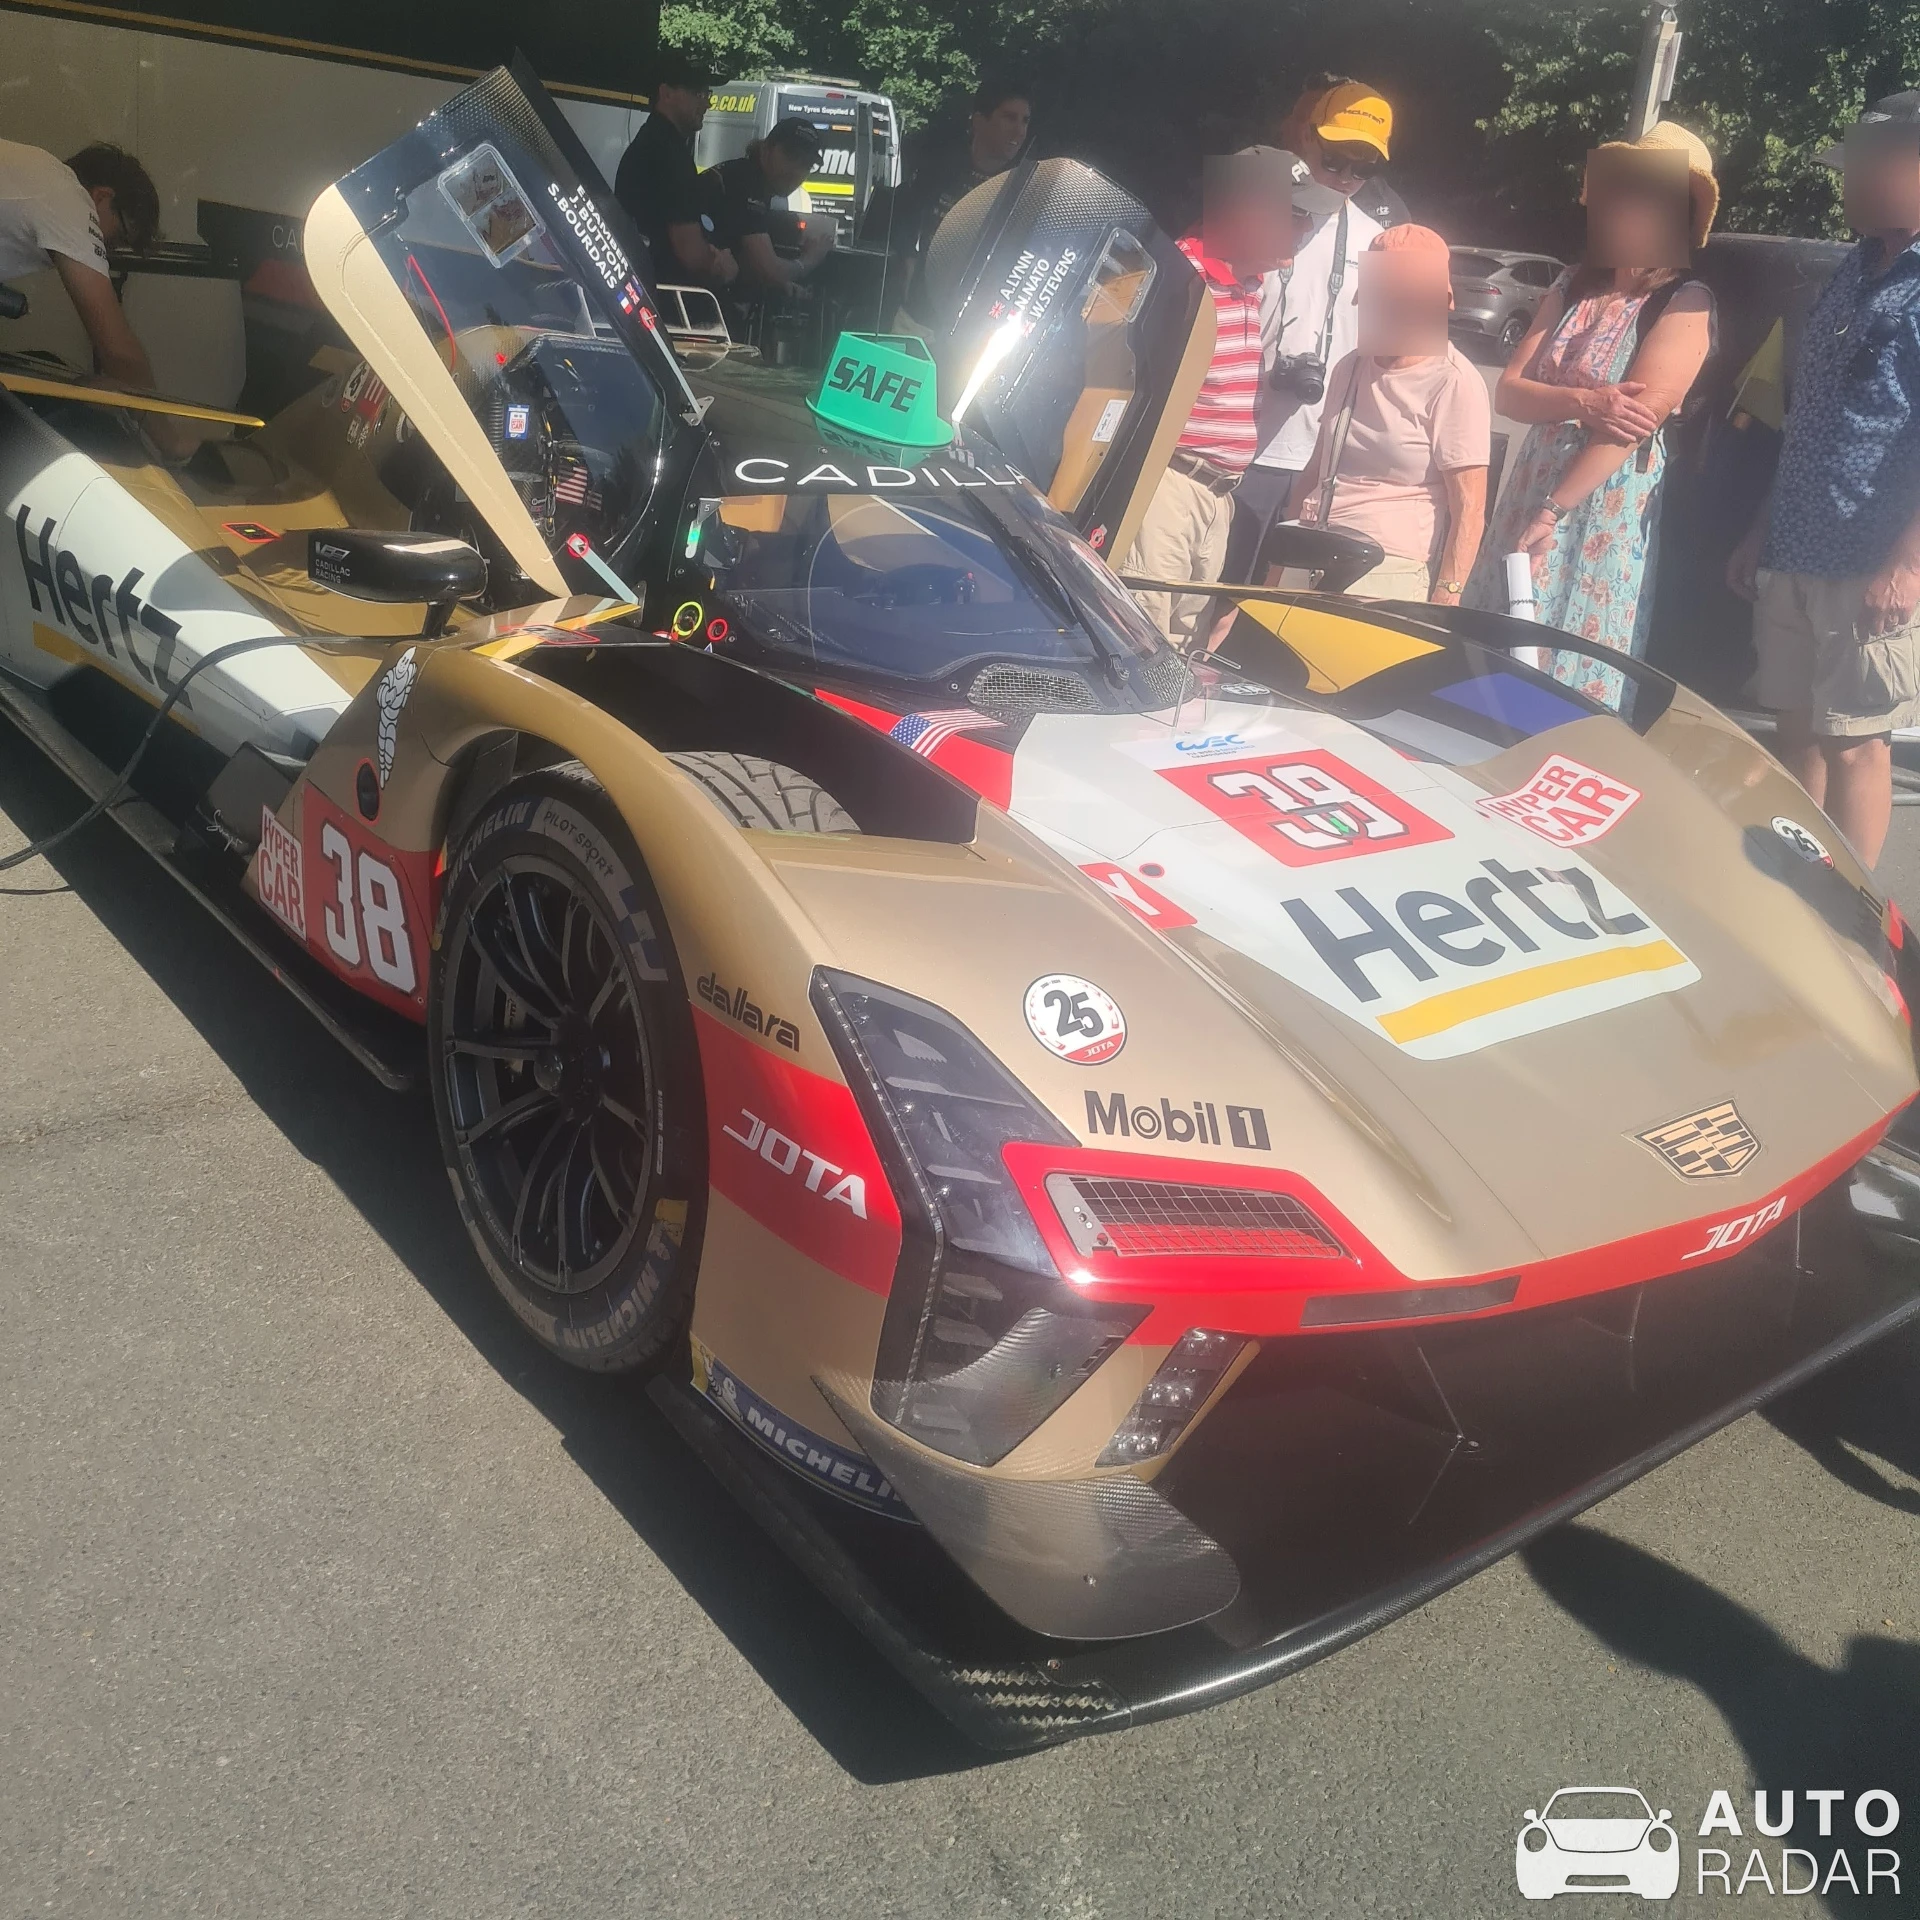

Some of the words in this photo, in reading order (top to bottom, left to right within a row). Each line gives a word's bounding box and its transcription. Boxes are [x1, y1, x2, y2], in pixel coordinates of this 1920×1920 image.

[708, 93, 757, 112] e.co.uk
[788, 104, 803, 112] New
[803, 105, 820, 113] Tyres
[821, 106, 848, 115] Supplied
[272, 225, 304, 256] CA
[547, 182, 618, 290] S.BOURDAIS
[569, 194, 626, 281] J.BUTTON
[576, 184, 629, 272] E.BAMBER
[1000, 249, 1035, 301] A.LYNN
[1013, 258, 1050, 311] N.NATO
[1029, 247, 1077, 320] W.STEVENS
[828, 356, 923, 413] SAFE
[315, 558, 351, 577] CADILLAC
[315, 568, 341, 584] RACING
[16, 503, 193, 711] Hertz
[1175, 734, 1246, 751] WEC
[1492, 764, 1581, 819] HYPER
[1521, 777, 1631, 842] CAR
[262, 811, 299, 878] HYPER
[544, 810, 577, 836] PILOT
[576, 832, 614, 877] SPORT
[1781, 825, 1820, 856] 25
[260, 847, 304, 931] CAR
[322, 822, 416, 994] 38
[1280, 858, 1651, 1003] Hertz
[697, 972, 799, 1053] dallara
[1044, 989, 1104, 1038] 25
[1083, 1040, 1116, 1059] JOTA
[1084, 1090, 1221, 1146] Mobil
[723, 1108, 868, 1220] JOTA
[1680, 1195, 1787, 1261] JOTA
[563, 1261, 660, 1349] MICHELIN
